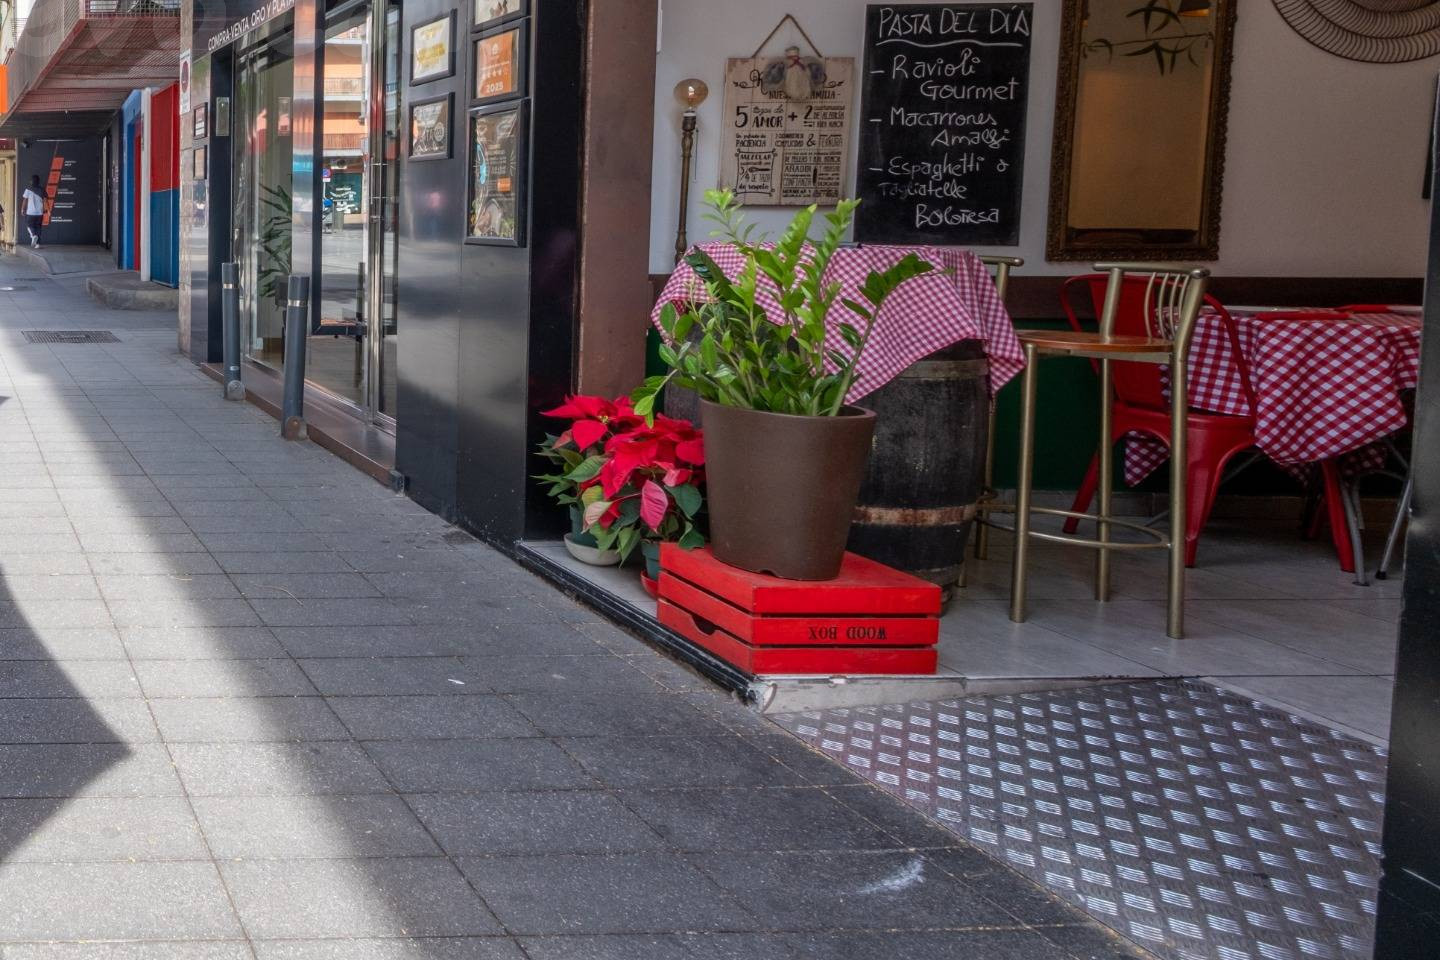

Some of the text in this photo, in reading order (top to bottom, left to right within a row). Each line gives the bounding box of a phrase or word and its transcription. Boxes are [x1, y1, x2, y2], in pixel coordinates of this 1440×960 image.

[208, 16, 250, 51] COMPRA-VENTA
[251, 8, 266, 26] ORO
[879, 7, 932, 38] PASTA
[939, 7, 979, 35] DEL
[892, 47, 981, 79] Ravioli
[920, 77, 1020, 100] Gourmet
[734, 105, 749, 128] 5
[890, 106, 998, 126] Macarrones
[887, 152, 985, 181] Espaghetti
[808, 626, 887, 641] WOOD BOX
